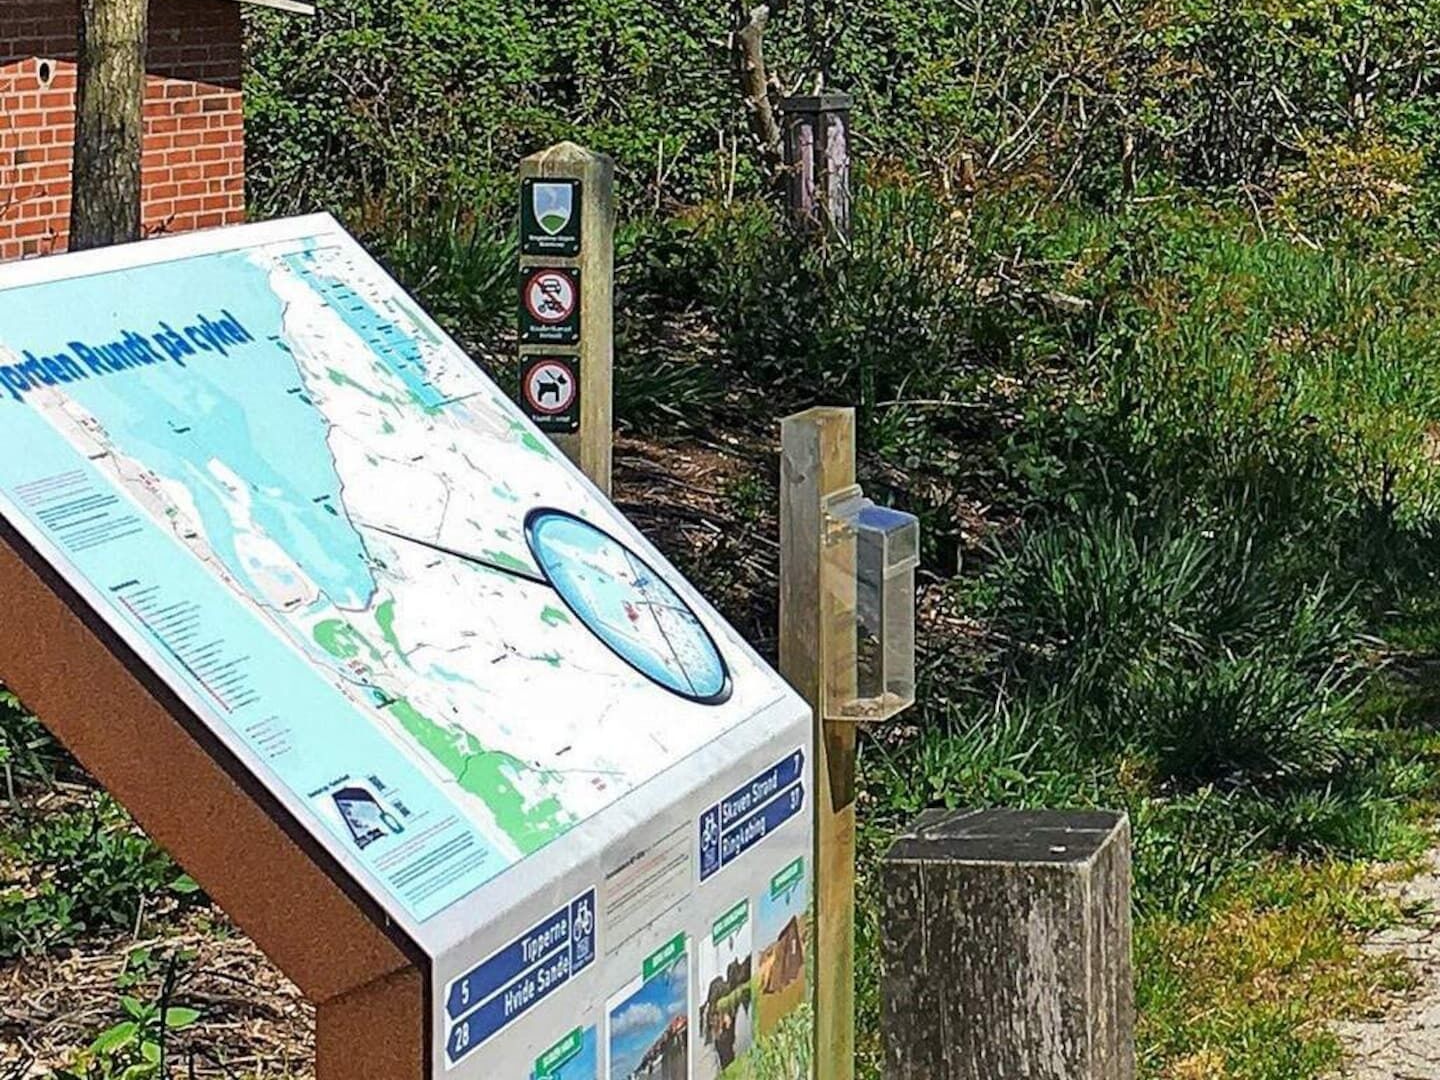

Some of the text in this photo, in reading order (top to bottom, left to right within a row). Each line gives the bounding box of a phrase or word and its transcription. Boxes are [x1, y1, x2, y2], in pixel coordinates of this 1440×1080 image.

[0, 309, 255, 403] jorden Rundt på cykel
[454, 1021, 470, 1052] 28
[504, 979, 536, 1017] Hvide
[537, 954, 570, 993] Sande
[461, 978, 470, 1005] 5
[521, 918, 568, 963] Tipperne
